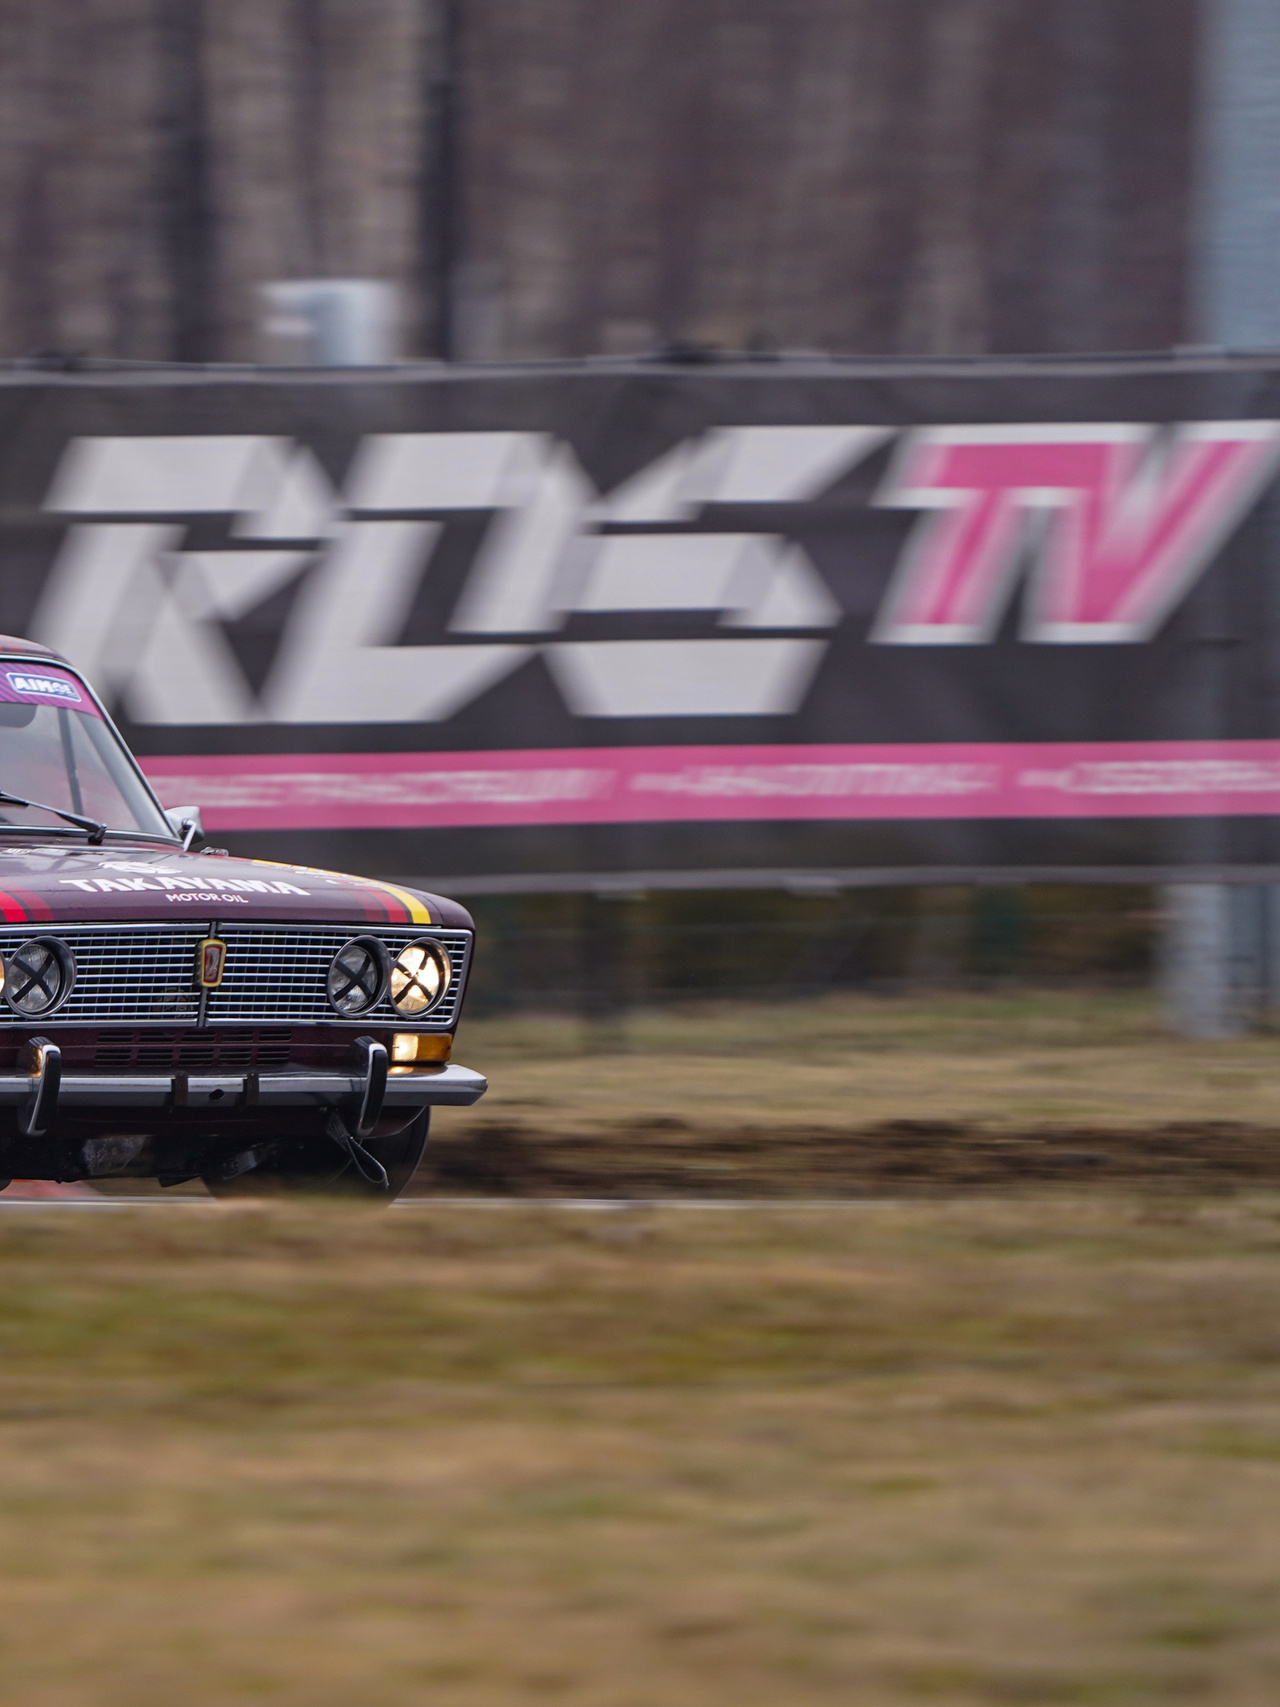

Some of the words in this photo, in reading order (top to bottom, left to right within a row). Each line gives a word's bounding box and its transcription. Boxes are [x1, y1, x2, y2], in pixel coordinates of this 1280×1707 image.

[59, 876, 311, 896] TAKAYAMA
[165, 893, 221, 902] MOTOR
[222, 894, 249, 903] OIL
